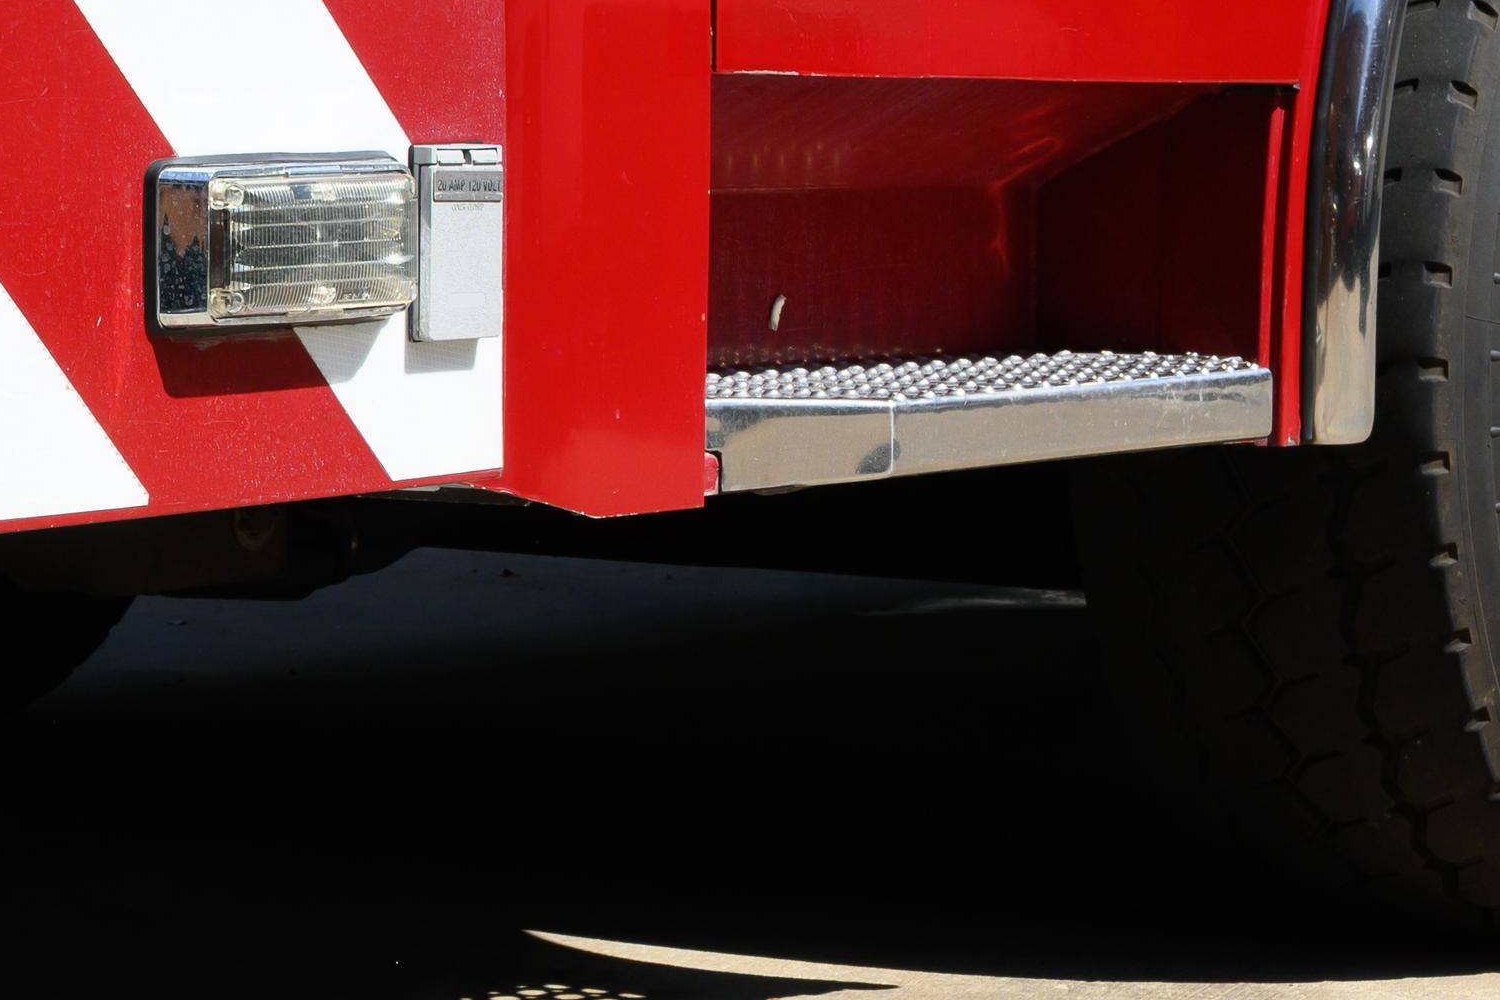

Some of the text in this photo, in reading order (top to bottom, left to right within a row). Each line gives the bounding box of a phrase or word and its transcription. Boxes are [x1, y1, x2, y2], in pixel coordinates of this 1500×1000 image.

[437, 179, 447, 192] 20
[449, 179, 466, 192] AMP
[468, 179, 482, 192] 120
